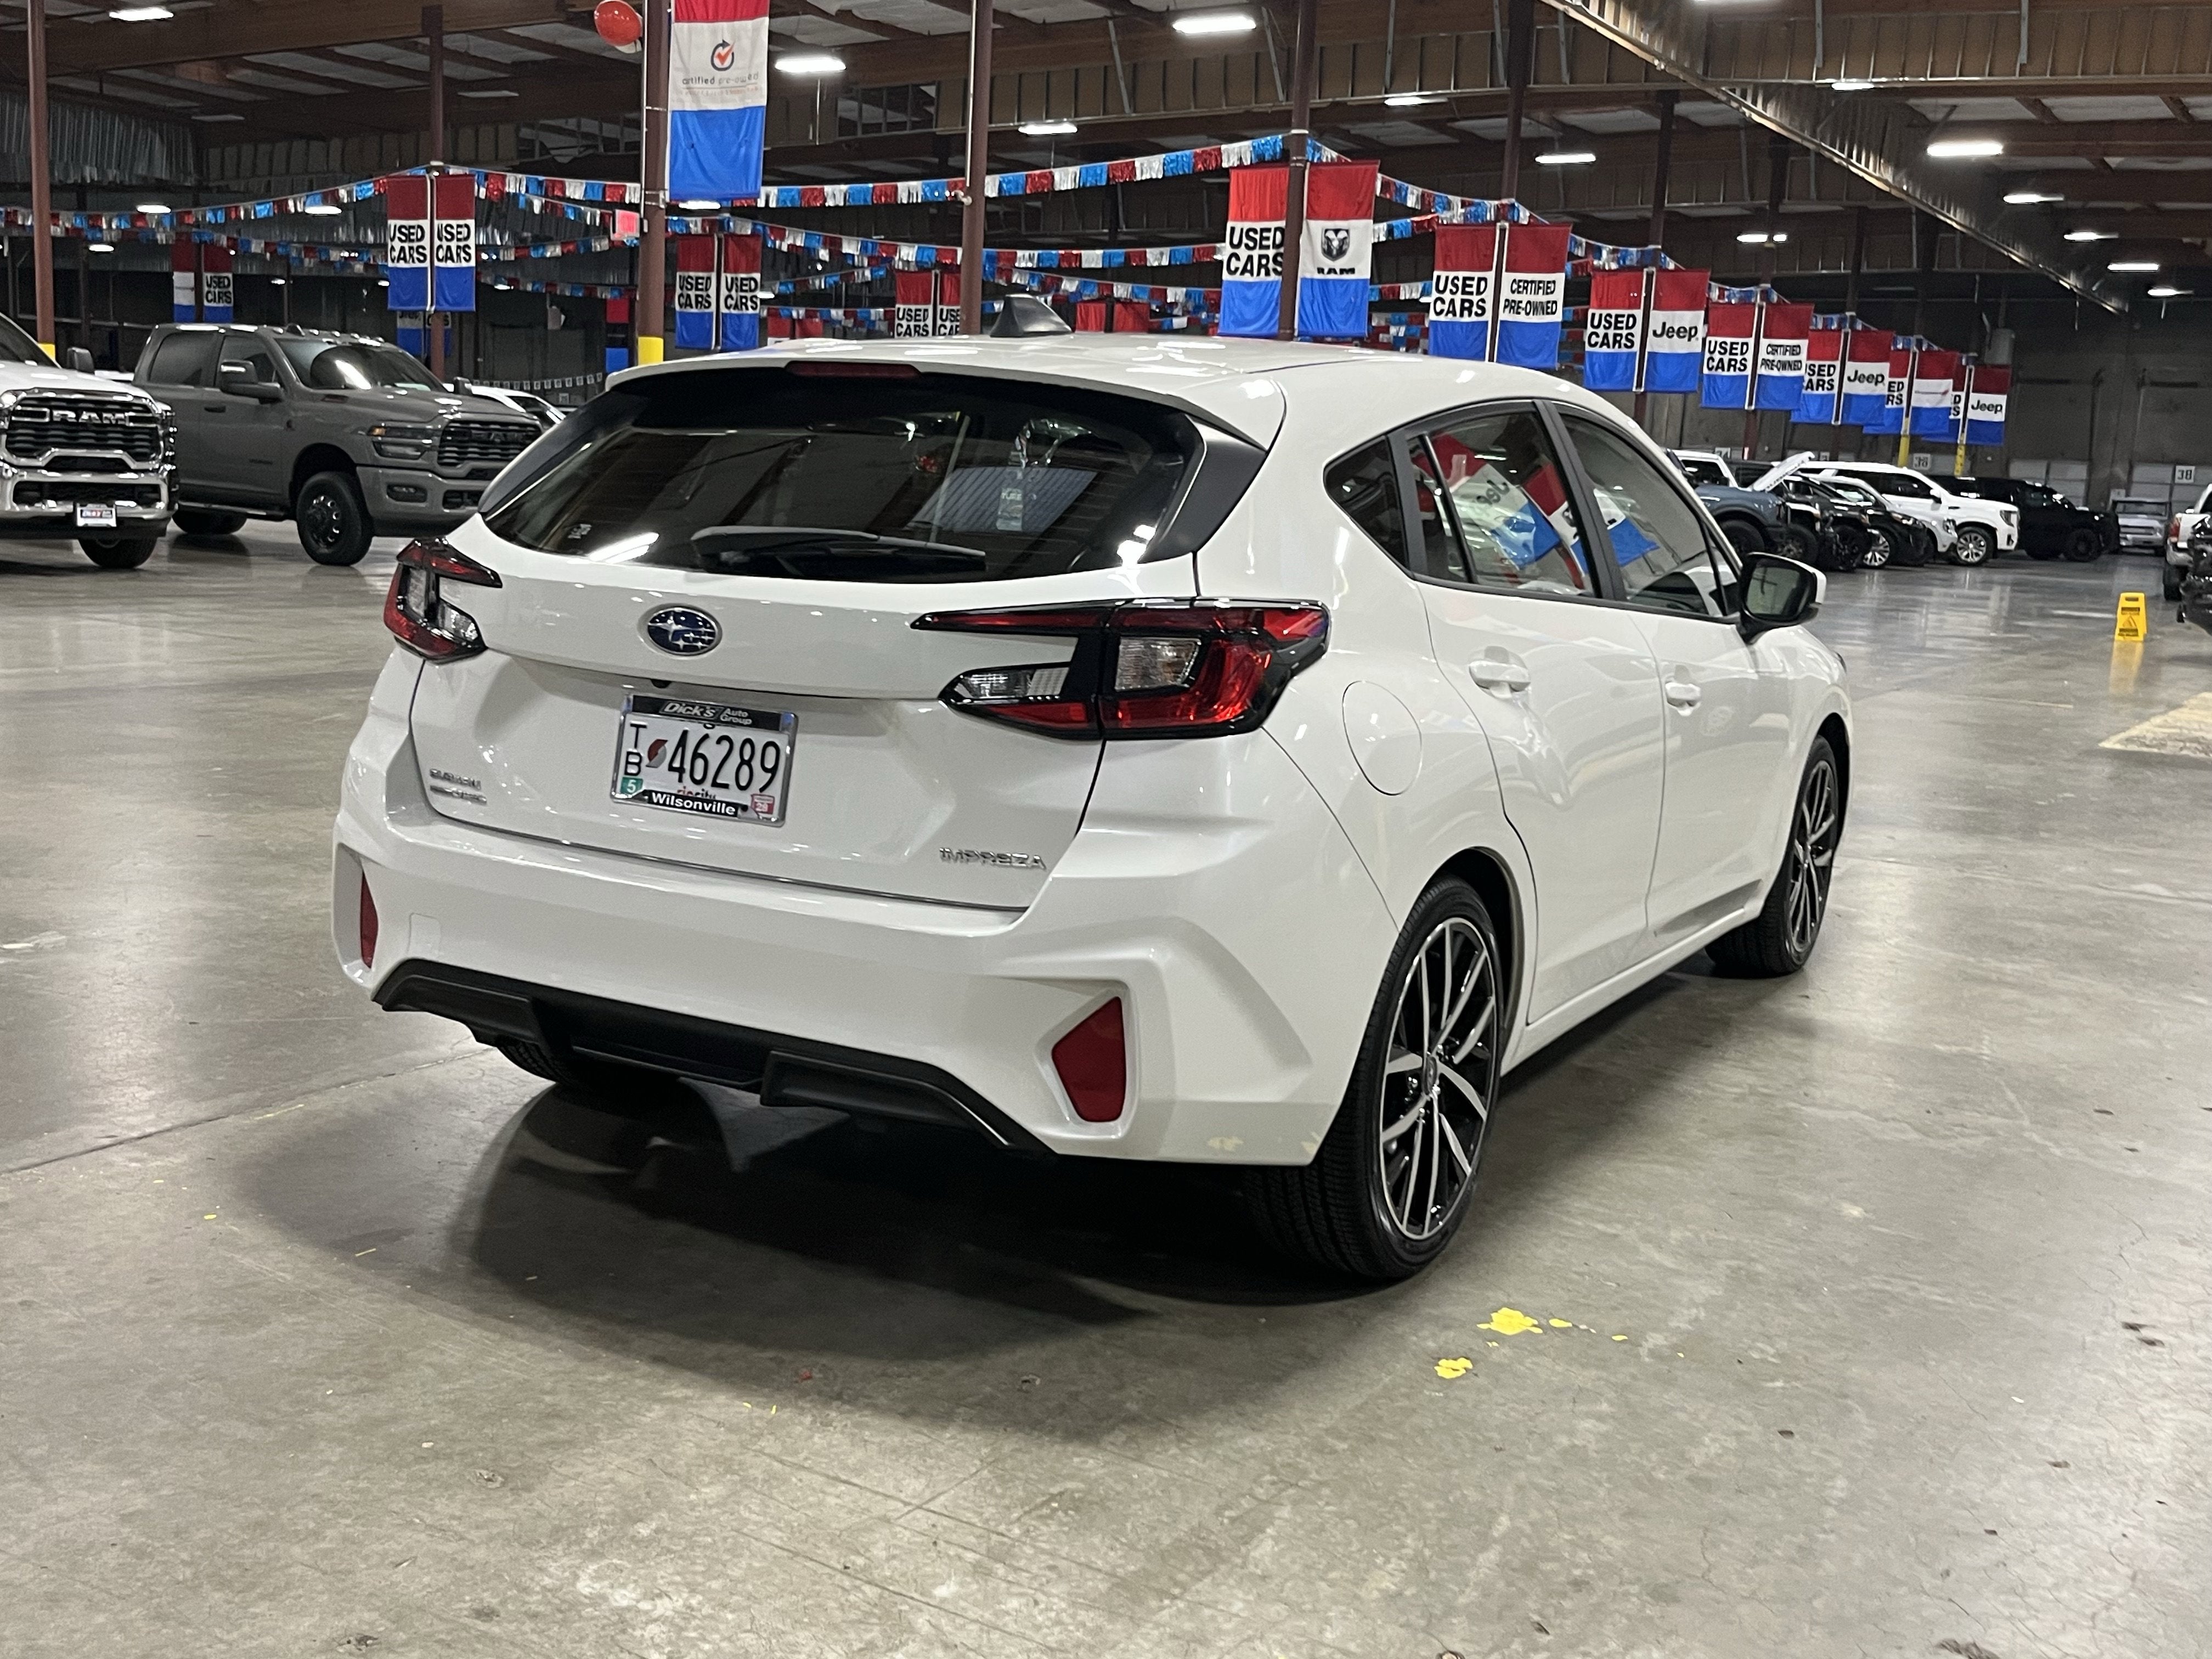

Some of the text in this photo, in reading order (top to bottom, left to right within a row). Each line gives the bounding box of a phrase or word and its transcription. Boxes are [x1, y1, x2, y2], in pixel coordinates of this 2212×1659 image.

[389, 224, 426, 242] USED
[437, 223, 471, 242] USED
[1229, 226, 1285, 251] USED
[389, 245, 428, 263] CARS
[436, 245, 472, 263] CARS
[1226, 252, 1283, 277] CARS
[206, 275, 231, 289] USED
[679, 275, 712, 291] USED
[725, 275, 759, 293] USED
[1435, 275, 1488, 296] USED
[1510, 278, 1556, 296] CERTIFIED
[678, 292, 712, 309] CARS
[724, 294, 758, 311] CARS
[1433, 296, 1486, 318] CARS
[1503, 298, 1558, 317] PRE-OWNED
[896, 307, 929, 323] USED
[939, 308, 960, 323] USE
[1590, 312, 1637, 330] USED
[896, 323, 929, 337] CARS
[1652, 321, 1698, 342] Jeep
[1587, 331, 1635, 349] CARS
[1708, 340, 1749, 356] USED
[1765, 343, 1801, 356] CERTIFIED
[1706, 356, 1748, 373] CARS
[1760, 358, 1803, 371] PRE-OWNED
[1805, 363, 1836, 377] SED
[1805, 378, 1835, 391] ARS
[1847, 369, 1885, 386] Jeep
[1971, 399, 2003, 414] Jeep
[52, 410, 127, 425] RAM
[664, 702, 715, 718] Dick's
[724, 708, 749, 718] Auto
[720, 713, 753, 725] Group
[668, 729, 781, 793] 46289
[627, 780, 636, 793] 5
[651, 792, 736, 816] Wilsonville
